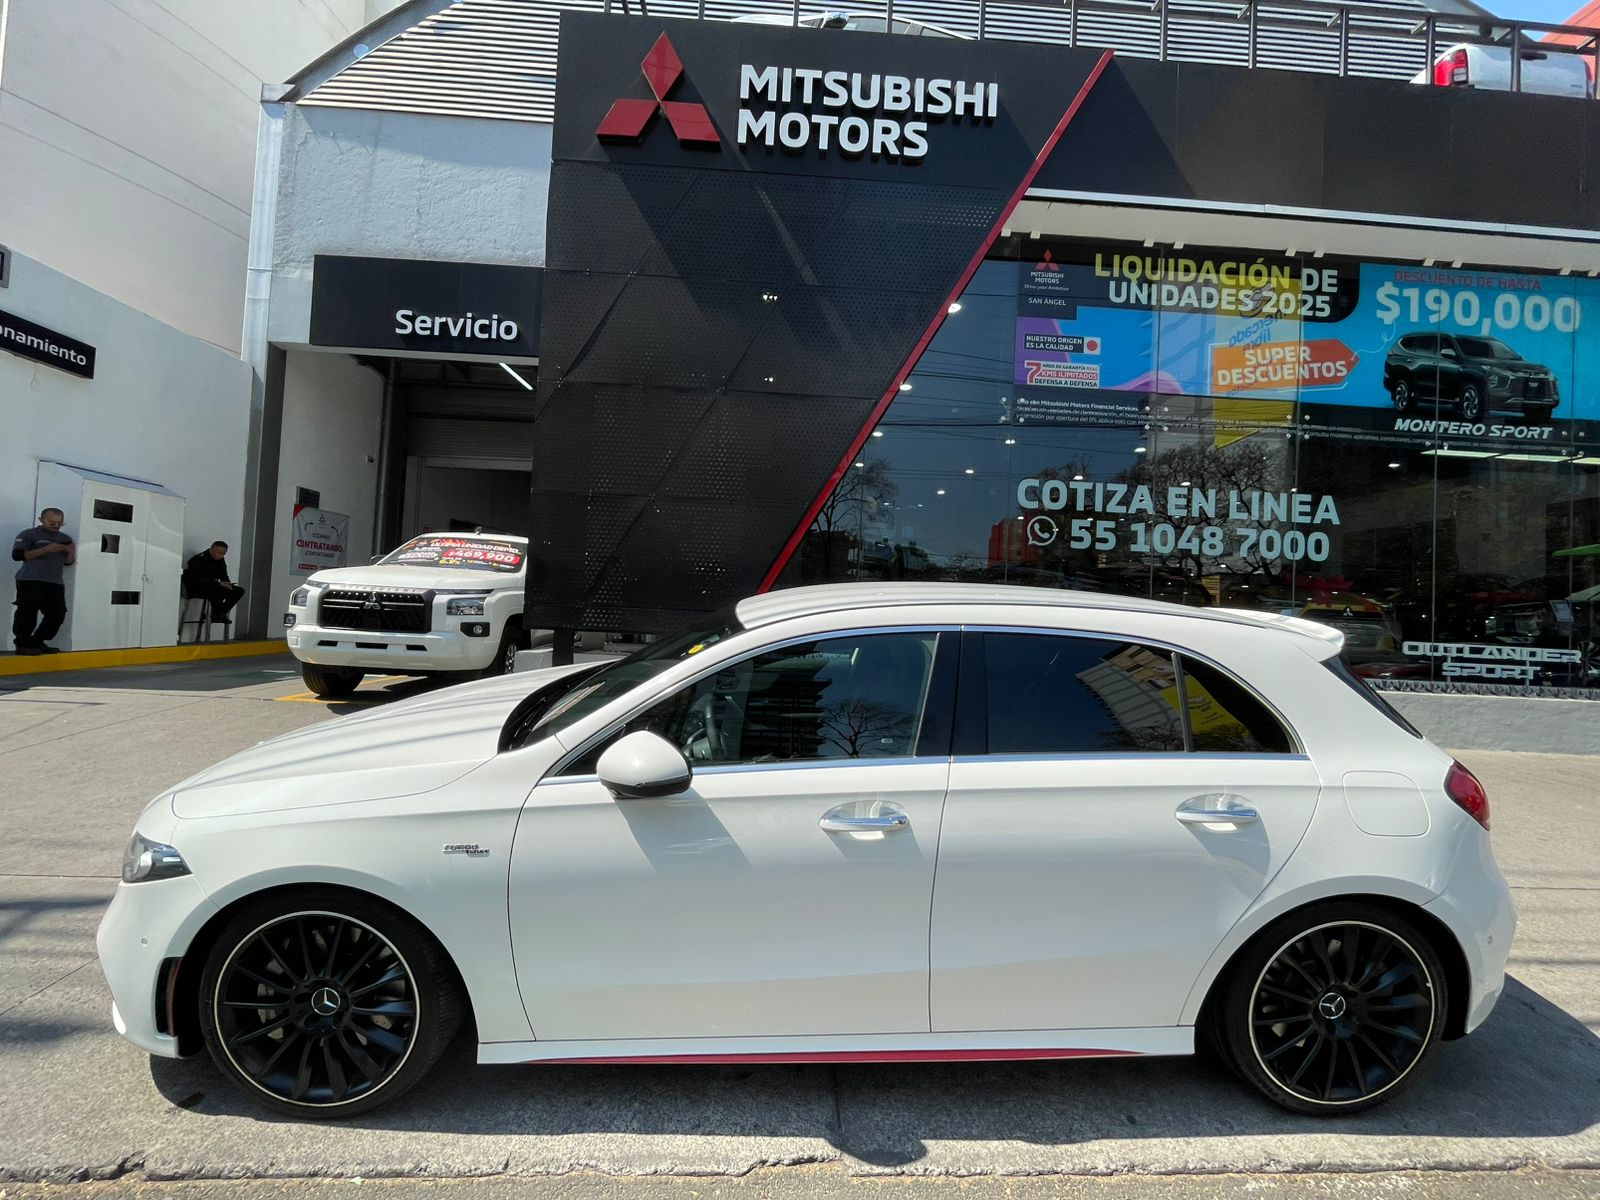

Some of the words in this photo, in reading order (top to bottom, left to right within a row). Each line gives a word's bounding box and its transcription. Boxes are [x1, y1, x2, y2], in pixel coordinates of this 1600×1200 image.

[739, 64, 998, 119] MITSUBISHI
[737, 108, 929, 158] MOTORS
[1030, 271, 1064, 279] MITSUBISHI
[1094, 253, 1291, 286] LIQUIDACIÓN
[1300, 267, 1338, 293] DE
[1394, 271, 1474, 287] DESCUENTO
[1476, 277, 1495, 288] DE
[1497, 278, 1543, 291] HASTA
[1044, 297, 1067, 306] ÁNGEL
[1109, 280, 1254, 312] UNIDADES
[1262, 291, 1332, 318] 2025
[1375, 281, 1581, 336] $190,000
[394, 309, 519, 342] Servicio
[1026, 335, 1057, 343] NUESTRO
[1244, 345, 1311, 366] SUPER
[1026, 361, 1041, 384] 7
[1058, 372, 1098, 380] ILIMITADOS
[1217, 360, 1348, 386] DESCUENTOS
[1394, 418, 1486, 436] MONTERO
[1488, 424, 1553, 440] SPORT
[1017, 477, 1155, 515] COTIZA
[1167, 487, 1217, 517] EN
[1229, 489, 1341, 526] LINEA
[296, 539, 343, 553] CONTRATANDO
[1070, 519, 1117, 551] 55
[1129, 522, 1224, 557] 1048
[1238, 527, 1330, 563] 7000
[448, 550, 514, 562] $469,900
[1402, 641, 1582, 664] OUTLANDER
[1441, 662, 1542, 680] SPORT
